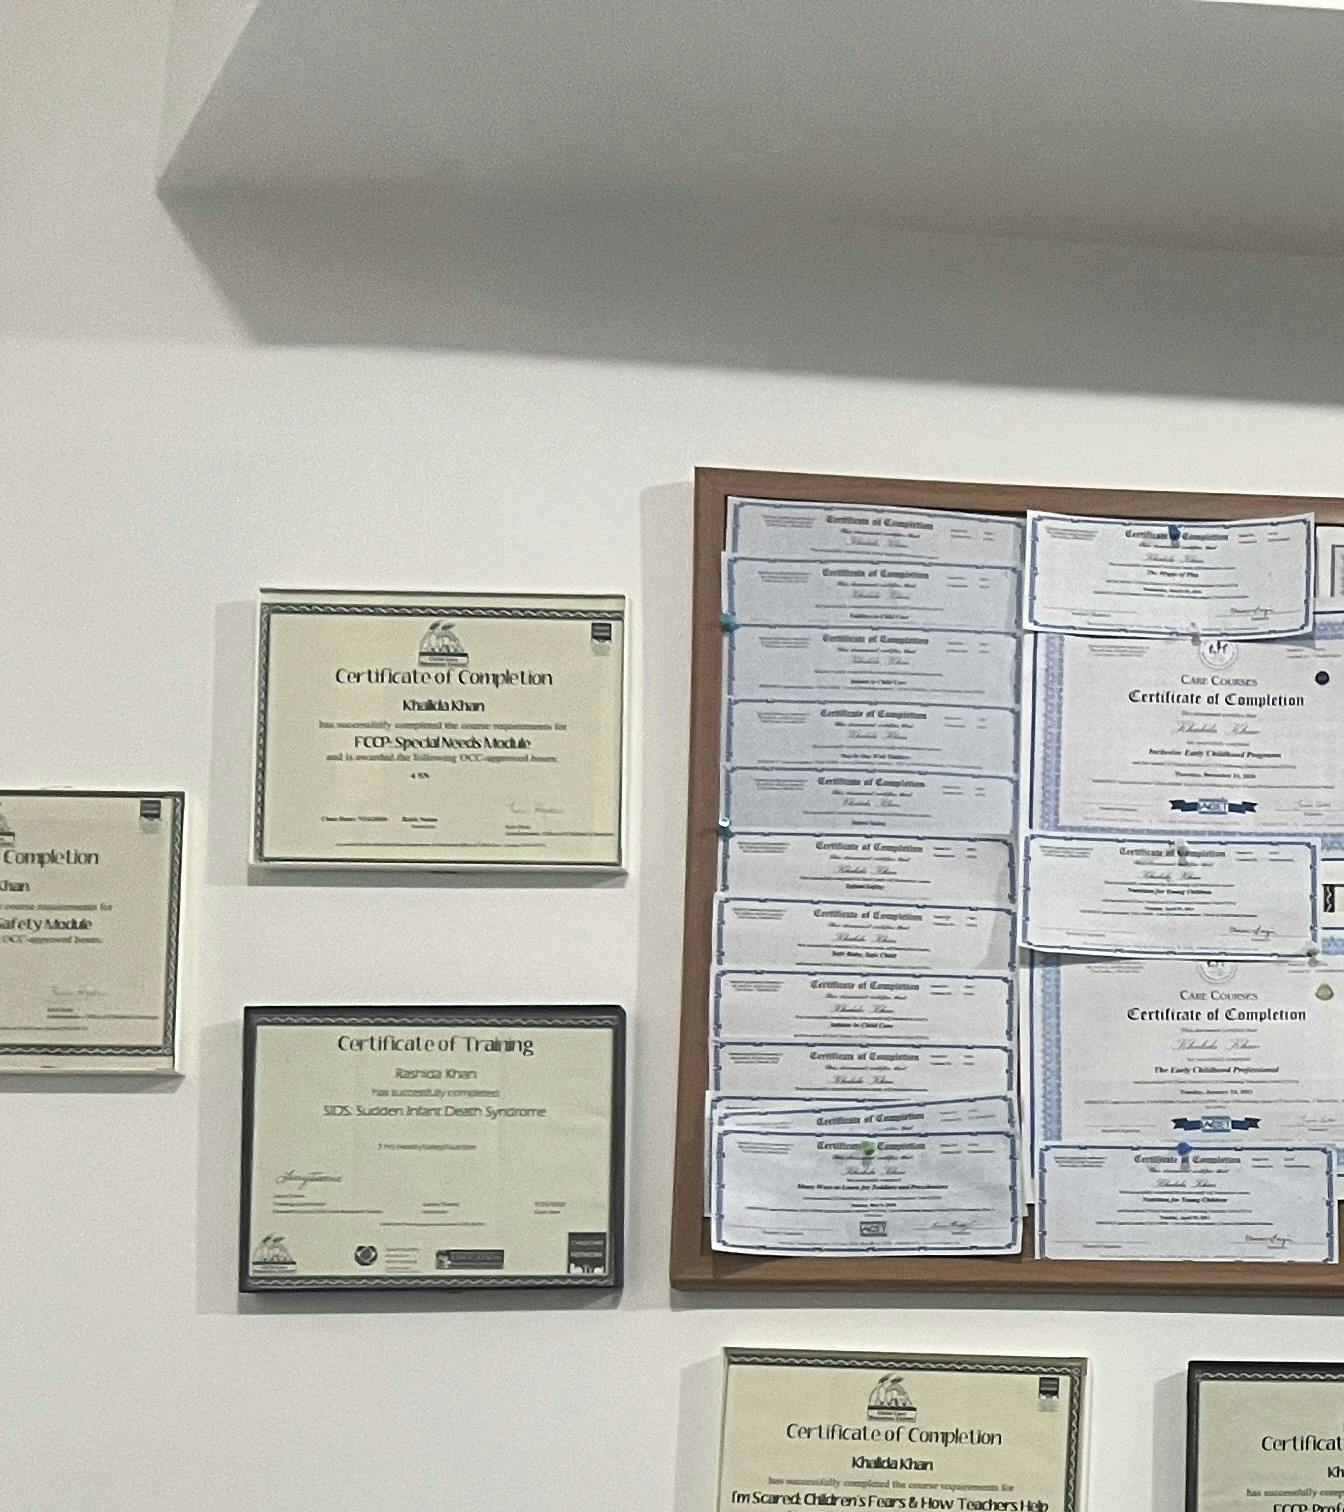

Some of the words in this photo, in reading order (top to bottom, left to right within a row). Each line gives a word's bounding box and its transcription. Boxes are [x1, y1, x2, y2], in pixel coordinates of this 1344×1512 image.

[336, 668, 432, 684] Certificate
[435, 667, 451, 684] of
[459, 669, 553, 688] Completion
[451, 700, 485, 712] Khan
[1129, 691, 1201, 705] Certificate
[1207, 693, 1219, 706] of
[1225, 694, 1304, 707] Completion
[396, 737, 440, 750] Special
[442, 737, 480, 748] Needs
[484, 737, 530, 749] Module
[818, 777, 860, 786] Certificate
[864, 778, 873, 786] of
[876, 778, 925, 788] Completion
[4, 850, 98, 867] Completion
[46, 918, 92, 929] Module
[1127, 1008, 1202, 1021] Certificate
[1207, 1009, 1220, 1021] of
[1224, 1009, 1306, 1021] Completion
[338, 1036, 434, 1052] Certificate
[438, 1037, 456, 1051] of
[465, 1037, 534, 1056] Training
[446, 1069, 477, 1079] Khan
[356, 1105, 403, 1116] Sudden
[406, 1106, 442, 1116] Infant
[445, 1106, 481, 1117] Death
[486, 1107, 546, 1119] Syndrome
[787, 1423, 881, 1441] Certificate
[884, 1425, 905, 1442] of
[909, 1428, 1002, 1447] Completion
[852, 1456, 898, 1470] Khalida
[900, 1457, 933, 1471] Khan
[868, 1495, 906, 1509] Fears
[909, 1496, 918, 1508] &
[921, 1497, 953, 1510] How
[958, 1498, 1018, 1512] Teachers
